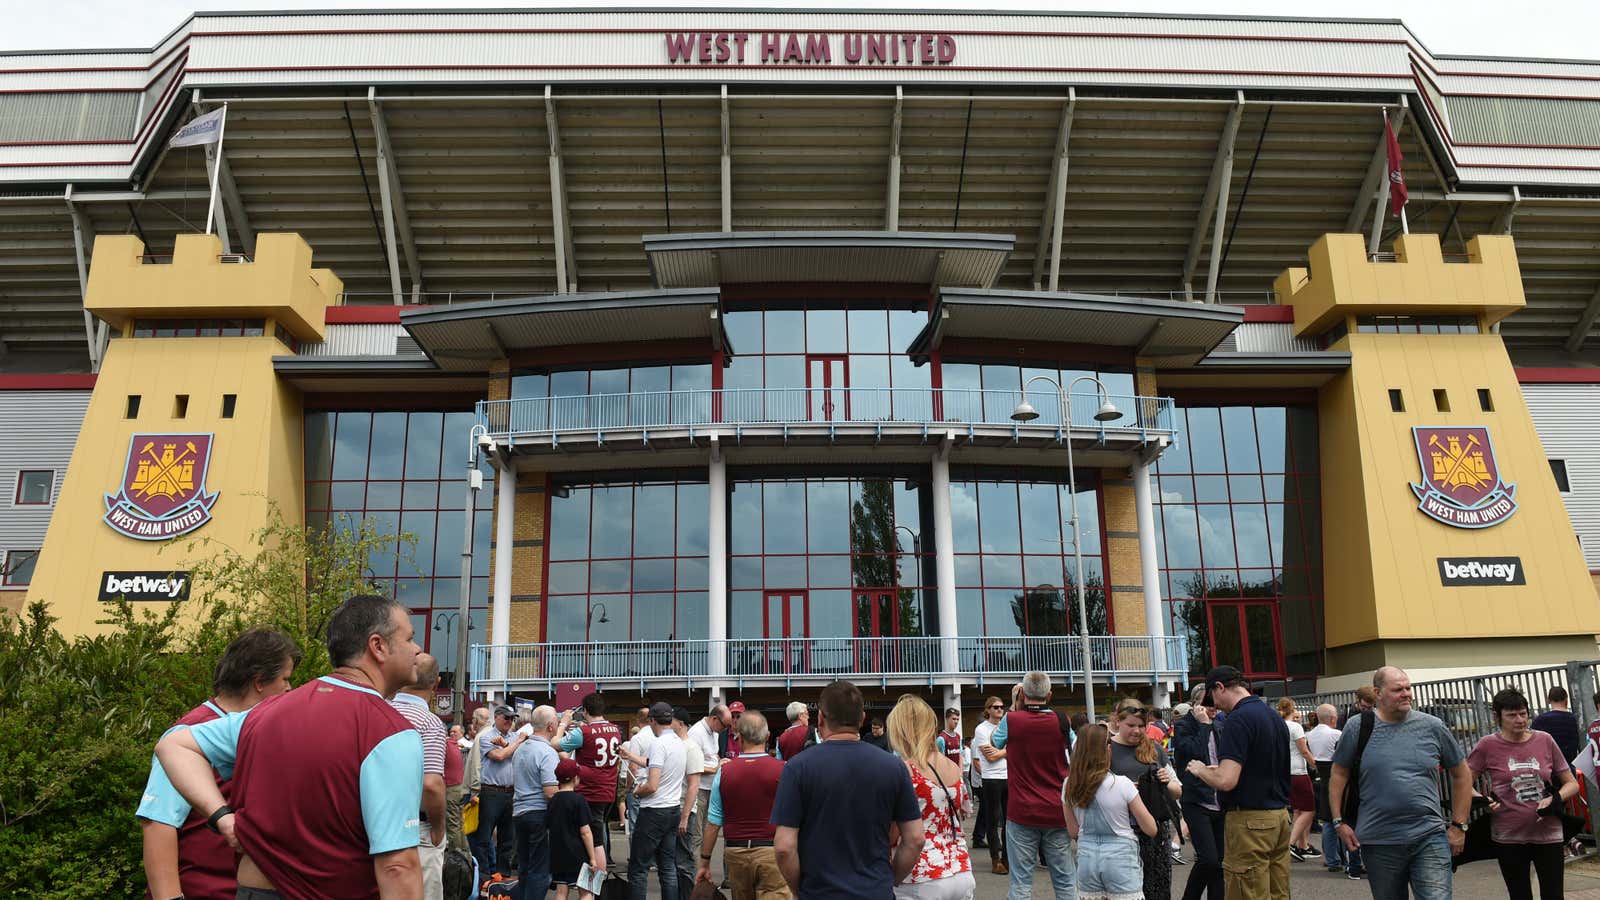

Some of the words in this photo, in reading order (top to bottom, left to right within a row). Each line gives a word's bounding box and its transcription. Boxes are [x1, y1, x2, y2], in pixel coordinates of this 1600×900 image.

[665, 32, 748, 62] WEST
[761, 32, 832, 62] HAM
[844, 33, 957, 63] UNITED
[111, 509, 136, 531] WEST
[137, 520, 162, 535] HAM
[164, 509, 202, 533] UNITED
[1427, 499, 1454, 519] WEST
[1456, 510, 1480, 523] HAM
[1480, 499, 1511, 522] UNITED
[1443, 560, 1516, 582] betway
[105, 574, 185, 598] betway
[594, 736, 619, 767] 39
